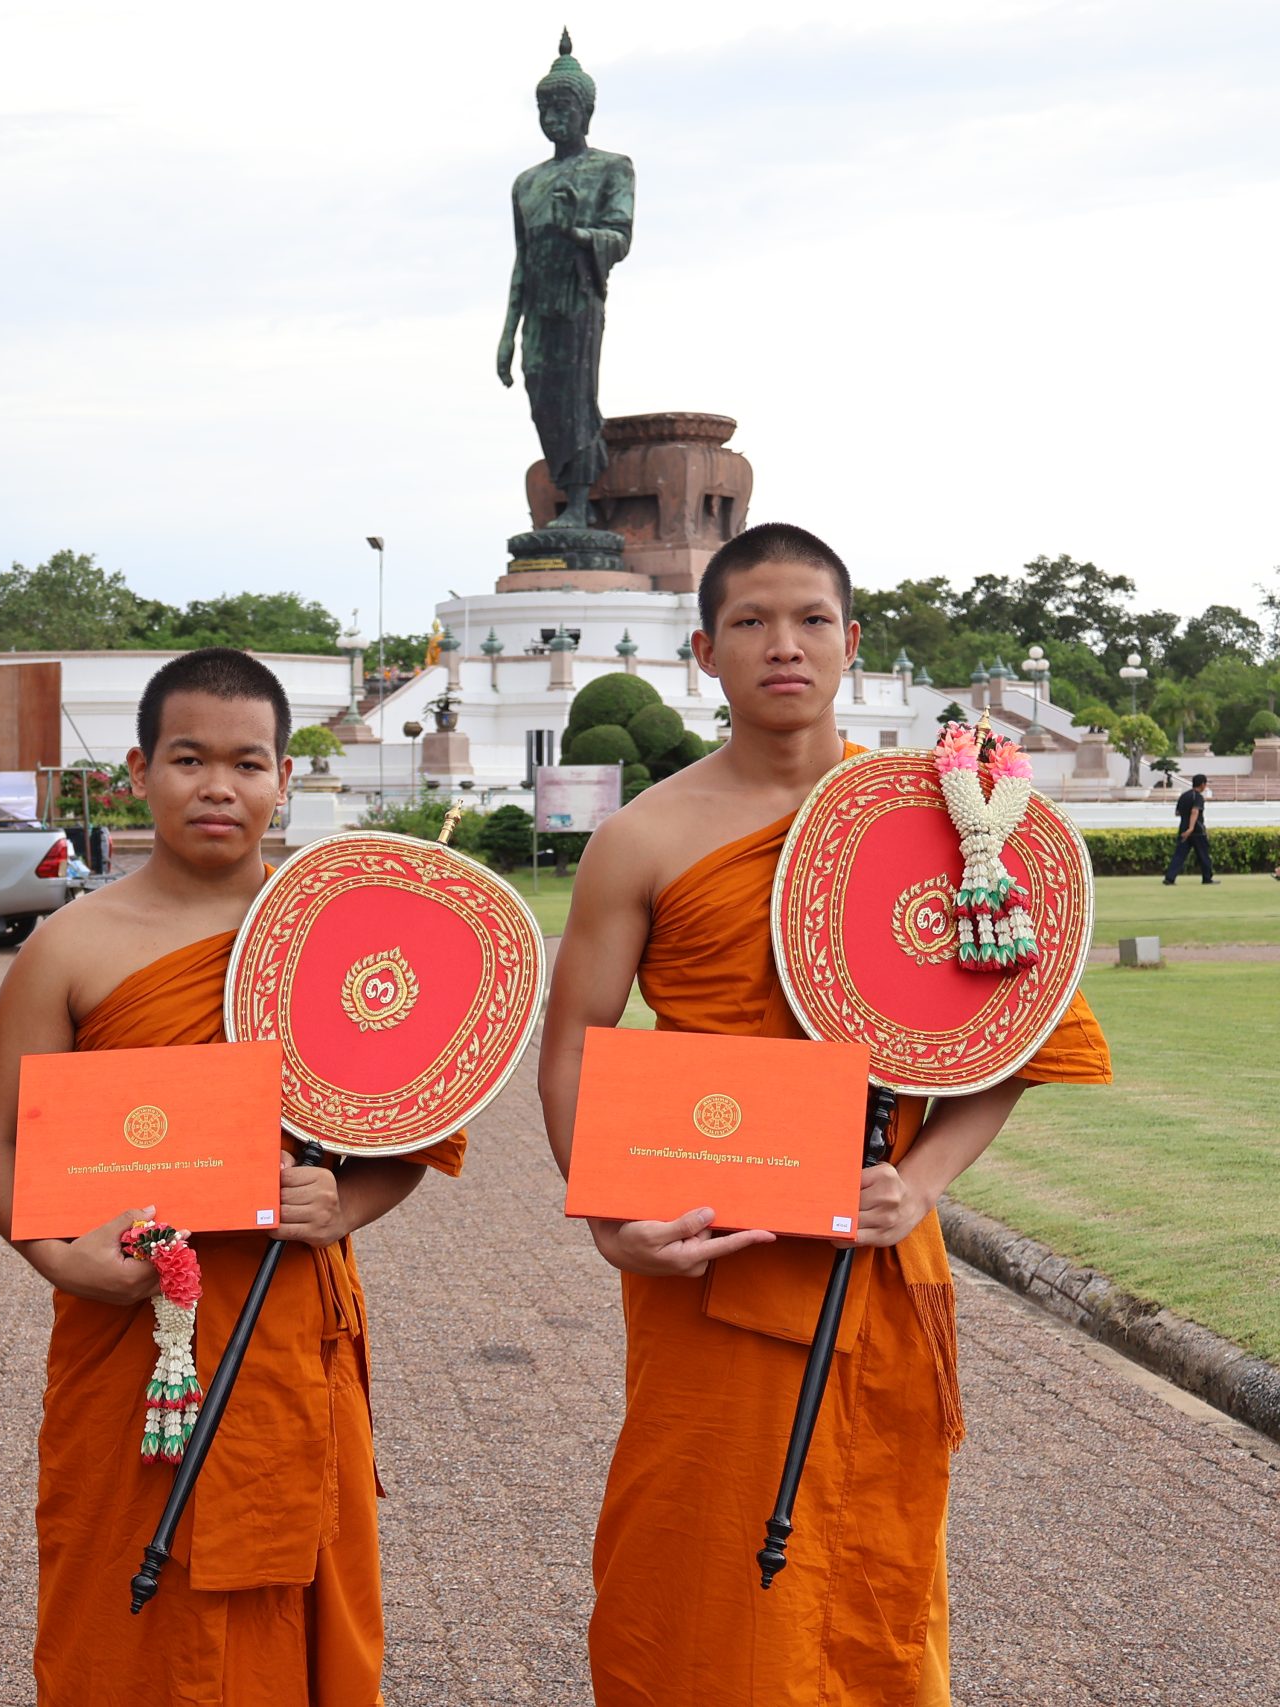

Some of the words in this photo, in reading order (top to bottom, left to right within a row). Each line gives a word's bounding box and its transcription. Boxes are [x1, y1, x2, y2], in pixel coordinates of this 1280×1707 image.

[916, 907, 946, 935] ๓
[365, 977, 395, 1004] ๓
[68, 1161, 172, 1175] ประกาศนียบัตรเปรียญธรรม
[175, 1161, 191, 1169] สาม
[194, 1157, 224, 1168] ประโยค
[630, 1146, 743, 1165] ประกาศนียบัตรเปรียญธรรม
[746, 1156, 764, 1165] สาม
[767, 1156, 800, 1168] ประโยค
